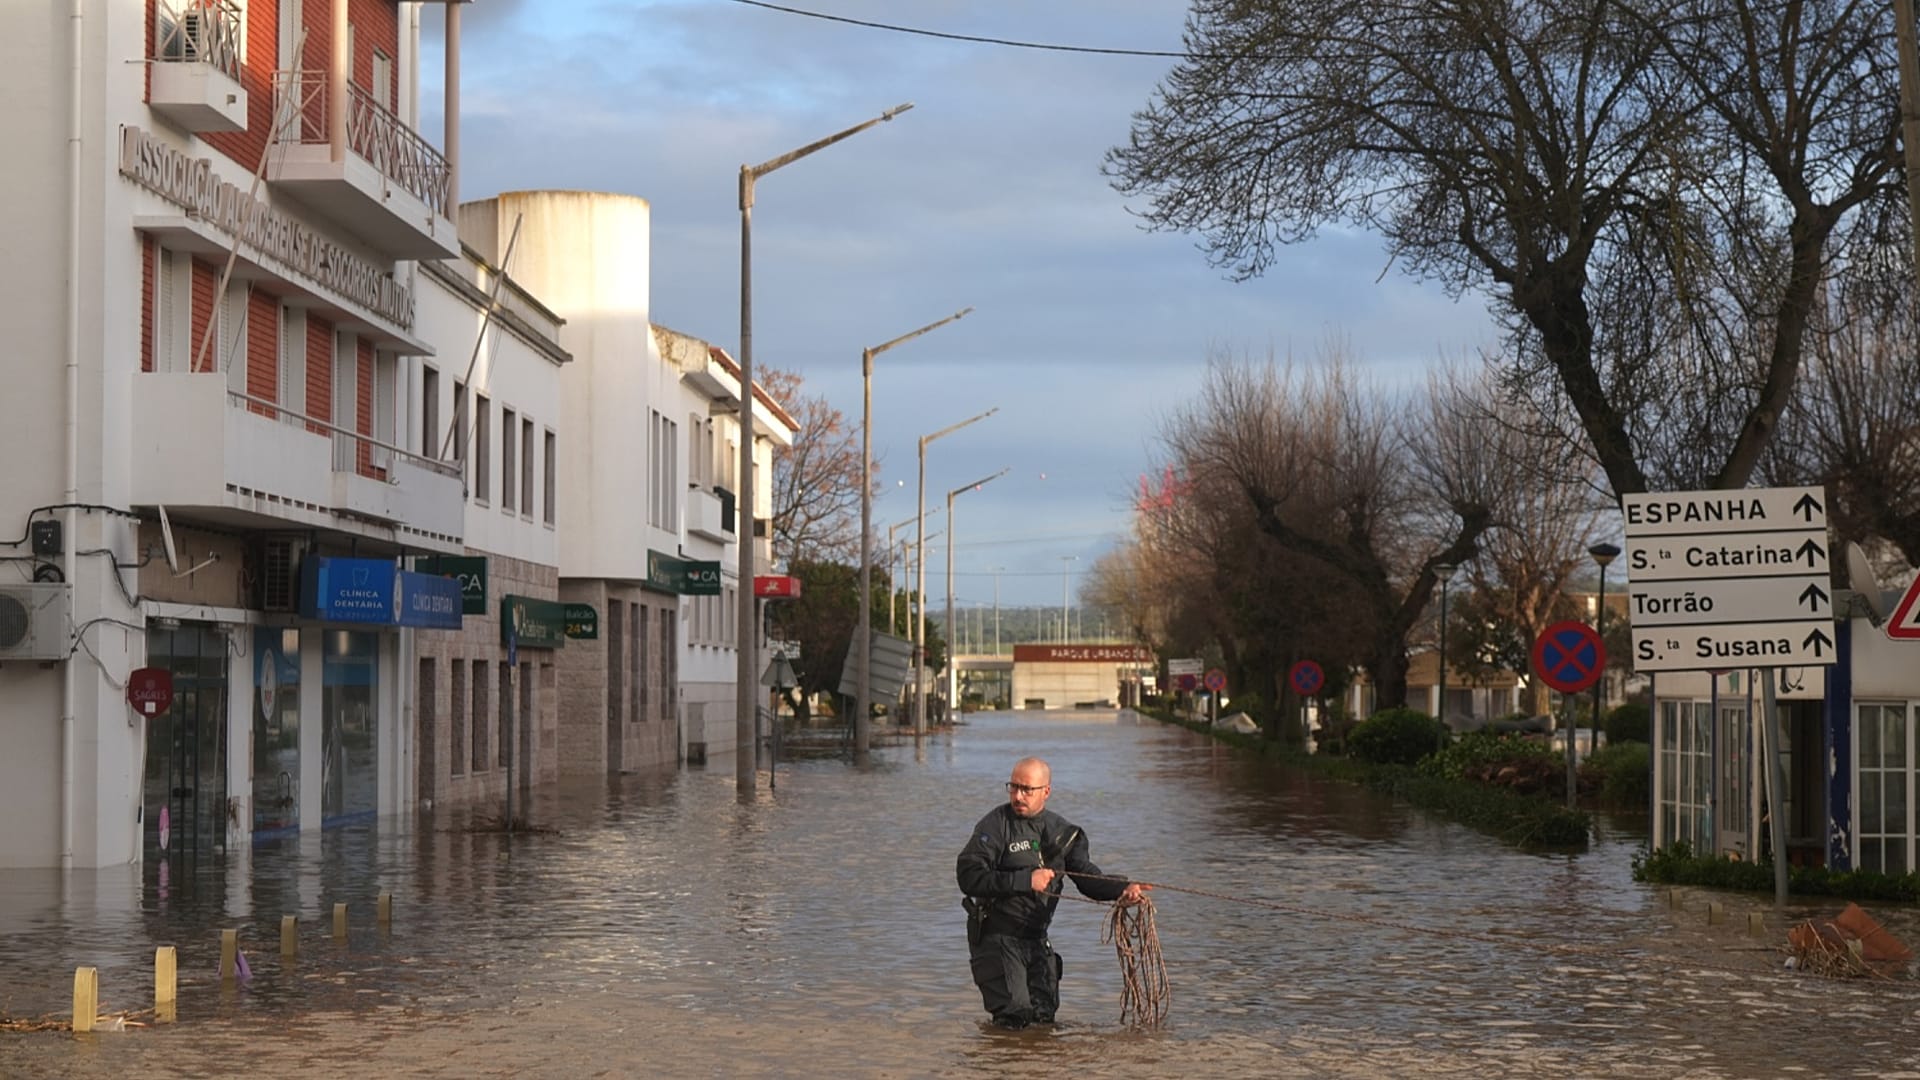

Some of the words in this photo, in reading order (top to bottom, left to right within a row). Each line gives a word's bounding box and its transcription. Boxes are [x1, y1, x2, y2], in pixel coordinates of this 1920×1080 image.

[310, 235, 326, 281] DE
[326, 244, 379, 309] SOCORROS
[1627, 499, 1766, 524] ESPANHA
[1686, 545, 1793, 568] Catarina
[701, 570, 719, 582] CA
[1632, 591, 1714, 614] Torrão
[566, 624, 582, 634] 24
[1050, 648, 1090, 659] PARQUE
[1091, 648, 1132, 659] URBANO
[1696, 637, 1792, 658] Susana
[1009, 840, 1031, 853] GNR
